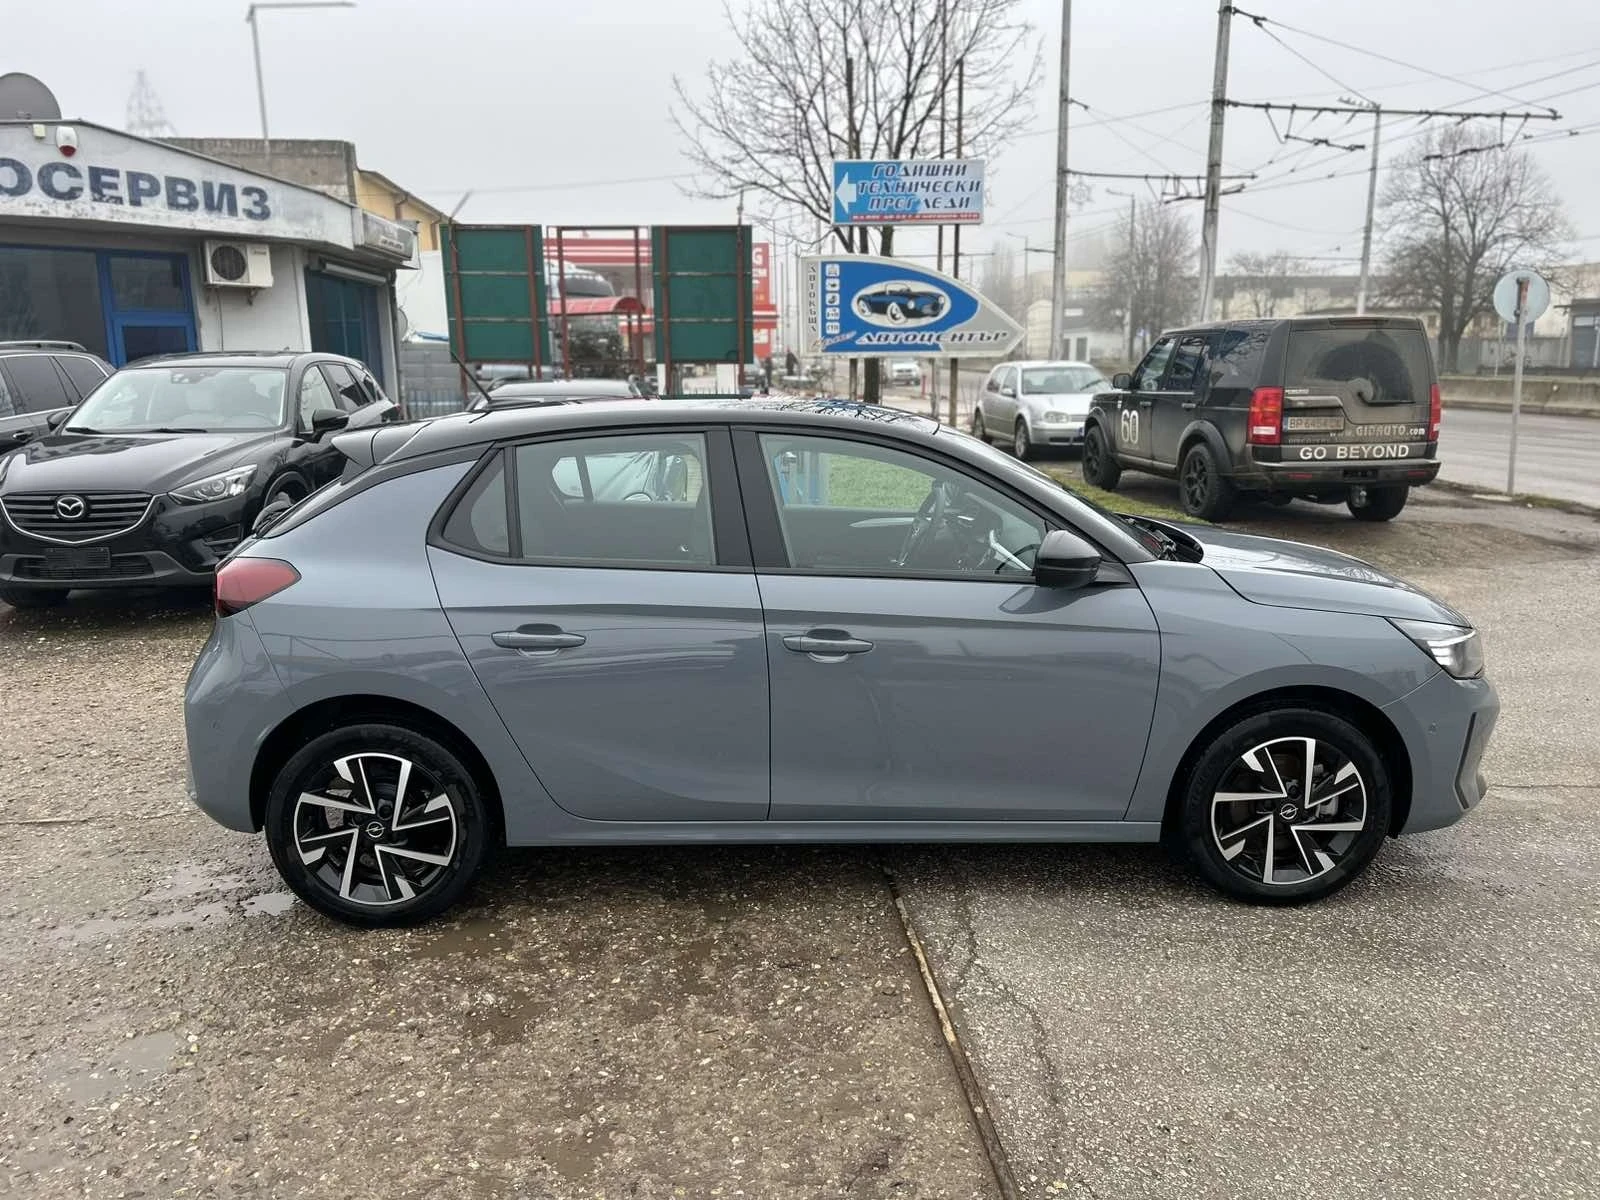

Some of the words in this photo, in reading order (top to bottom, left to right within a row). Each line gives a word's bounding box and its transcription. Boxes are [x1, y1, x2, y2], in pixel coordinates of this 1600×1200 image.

[872, 164, 967, 178] ГОДИШНИ
[0, 158, 271, 221] ОСЕРВИЗ
[857, 180, 982, 193] ТЕХНИЧЕСКИ
[857, 332, 1007, 345] АВТОЦЕНТЪР
[1121, 409, 1139, 444] 60
[1299, 446, 1327, 460] GO
[1336, 445, 1410, 459] BEYOND
